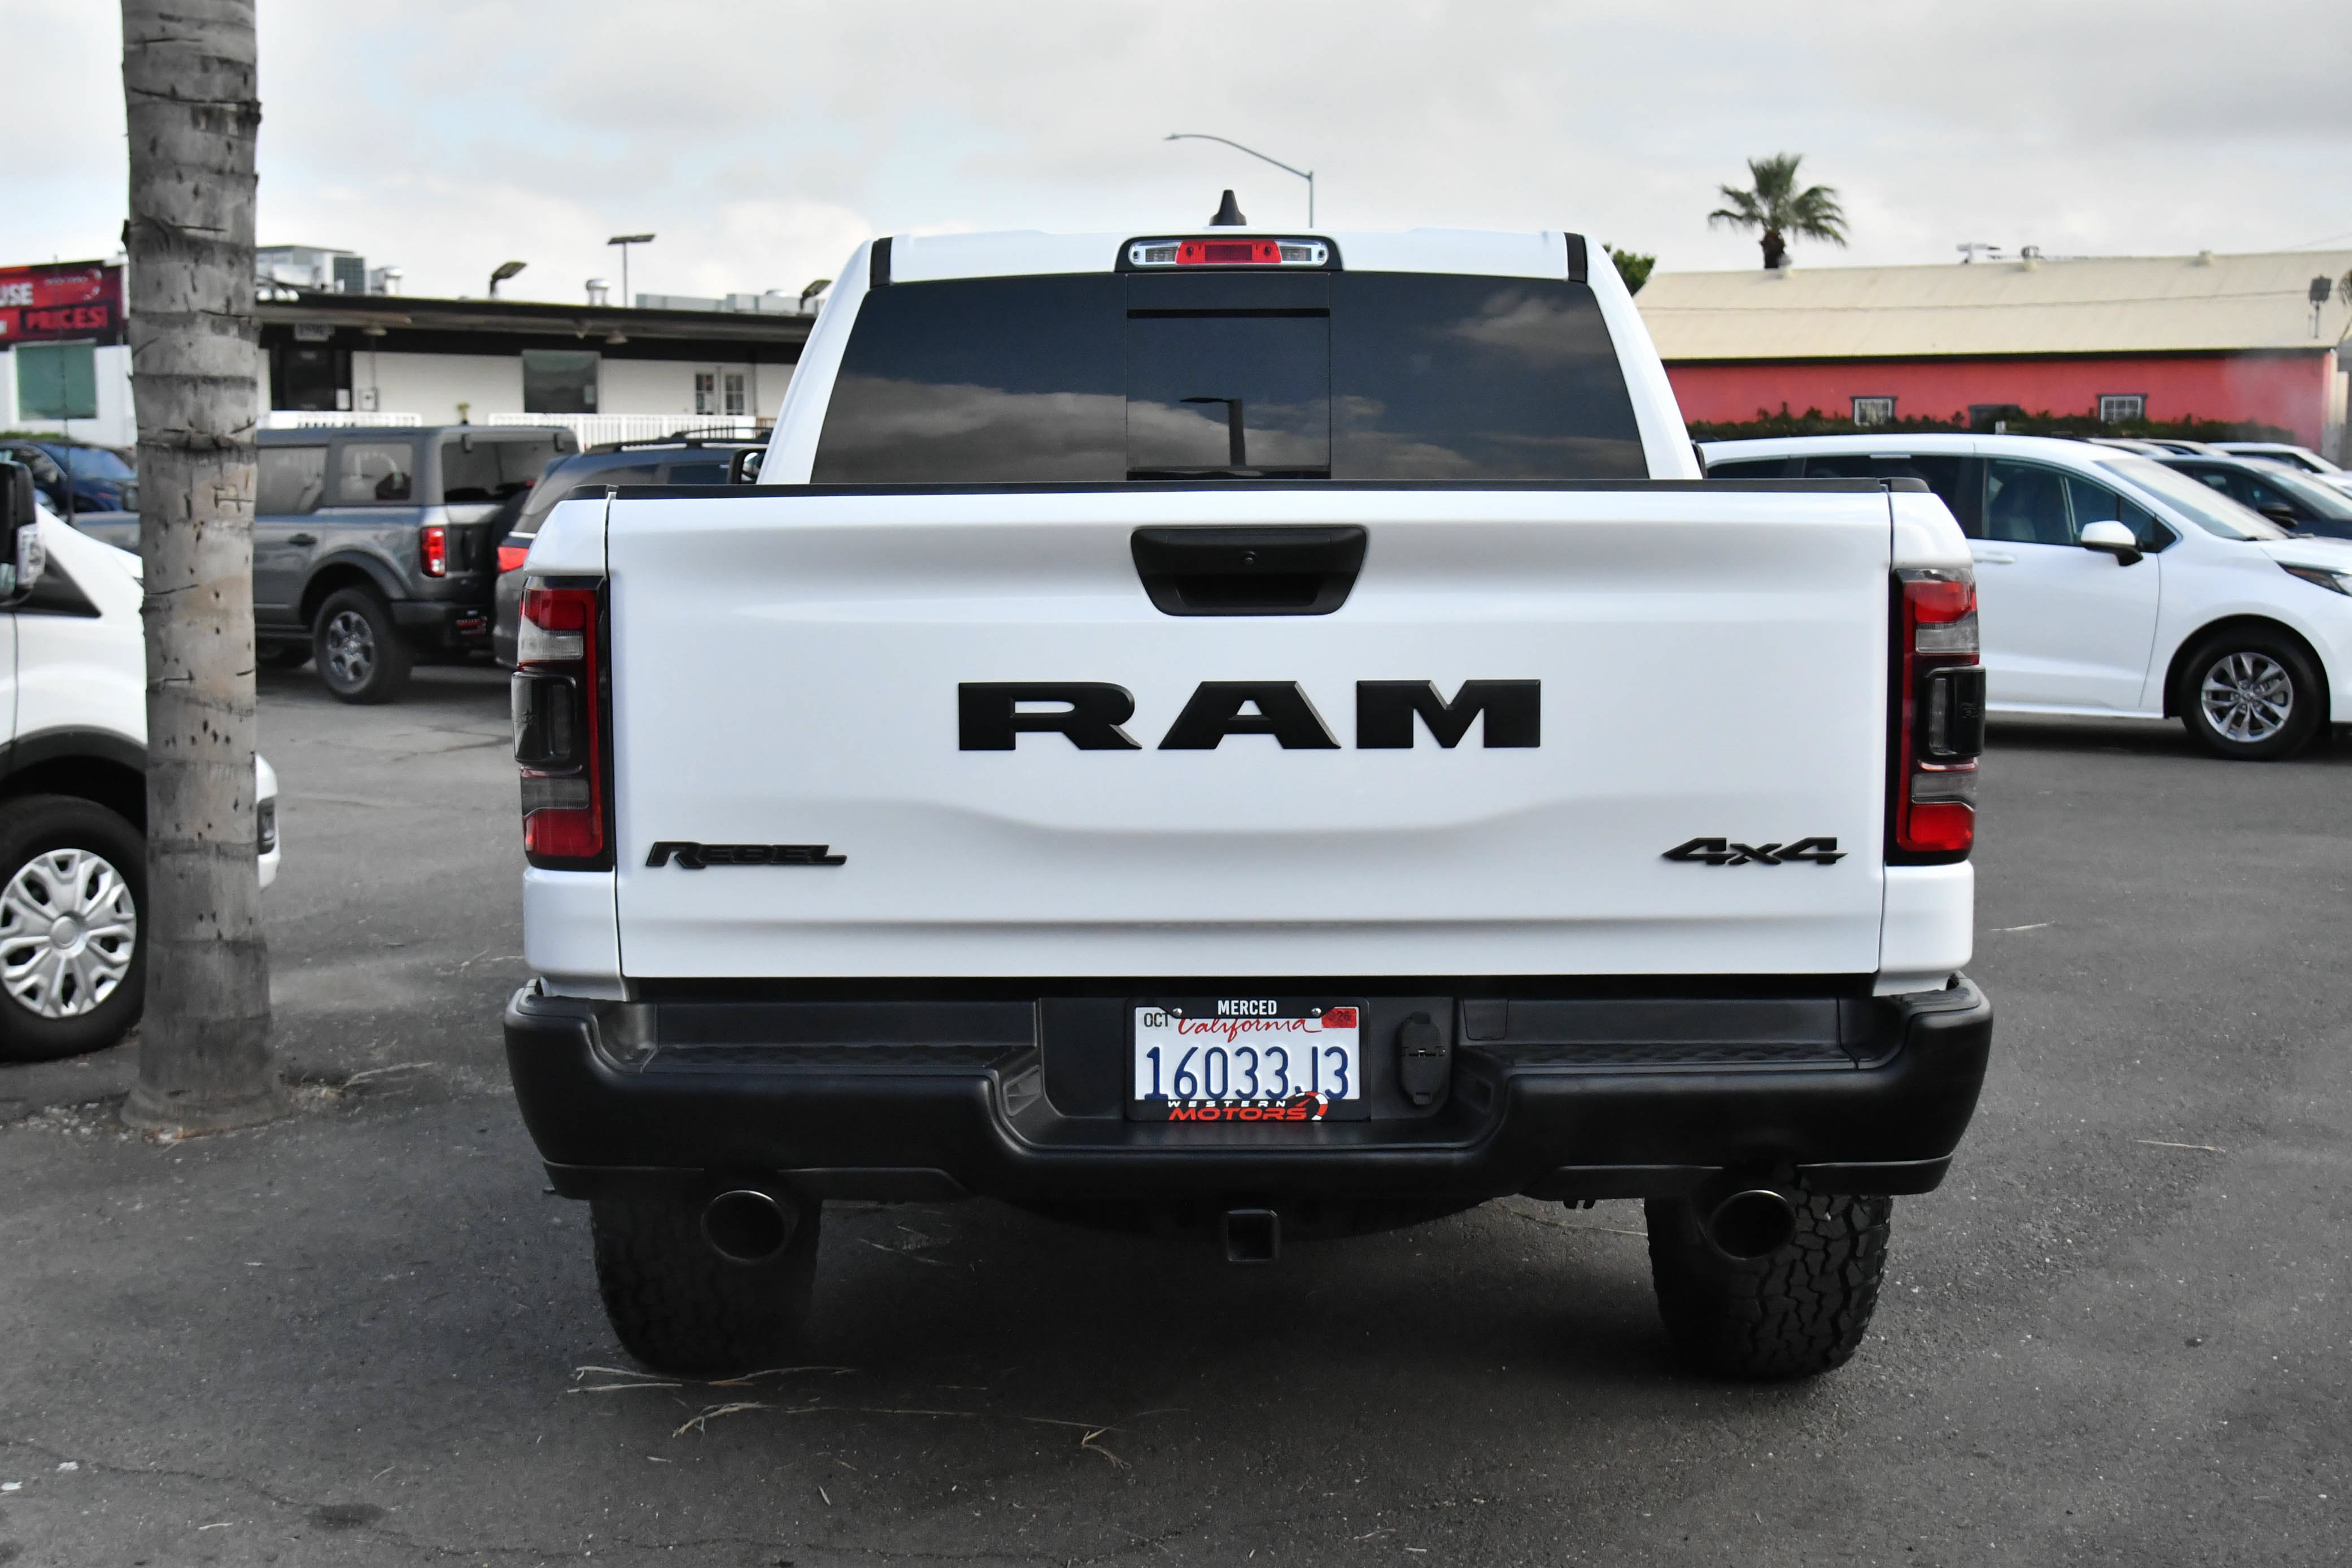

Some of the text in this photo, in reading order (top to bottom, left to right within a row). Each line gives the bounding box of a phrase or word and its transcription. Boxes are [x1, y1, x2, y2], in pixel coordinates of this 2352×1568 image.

[958, 679, 1541, 750] RAM
[1218, 1000, 1277, 1015] MERCED
[1144, 1012, 1169, 1028] OCT
[1178, 1018, 1322, 1043] California
[1144, 1046, 1349, 1100] 16033J3
[1168, 1107, 1307, 1121] MOTORS
